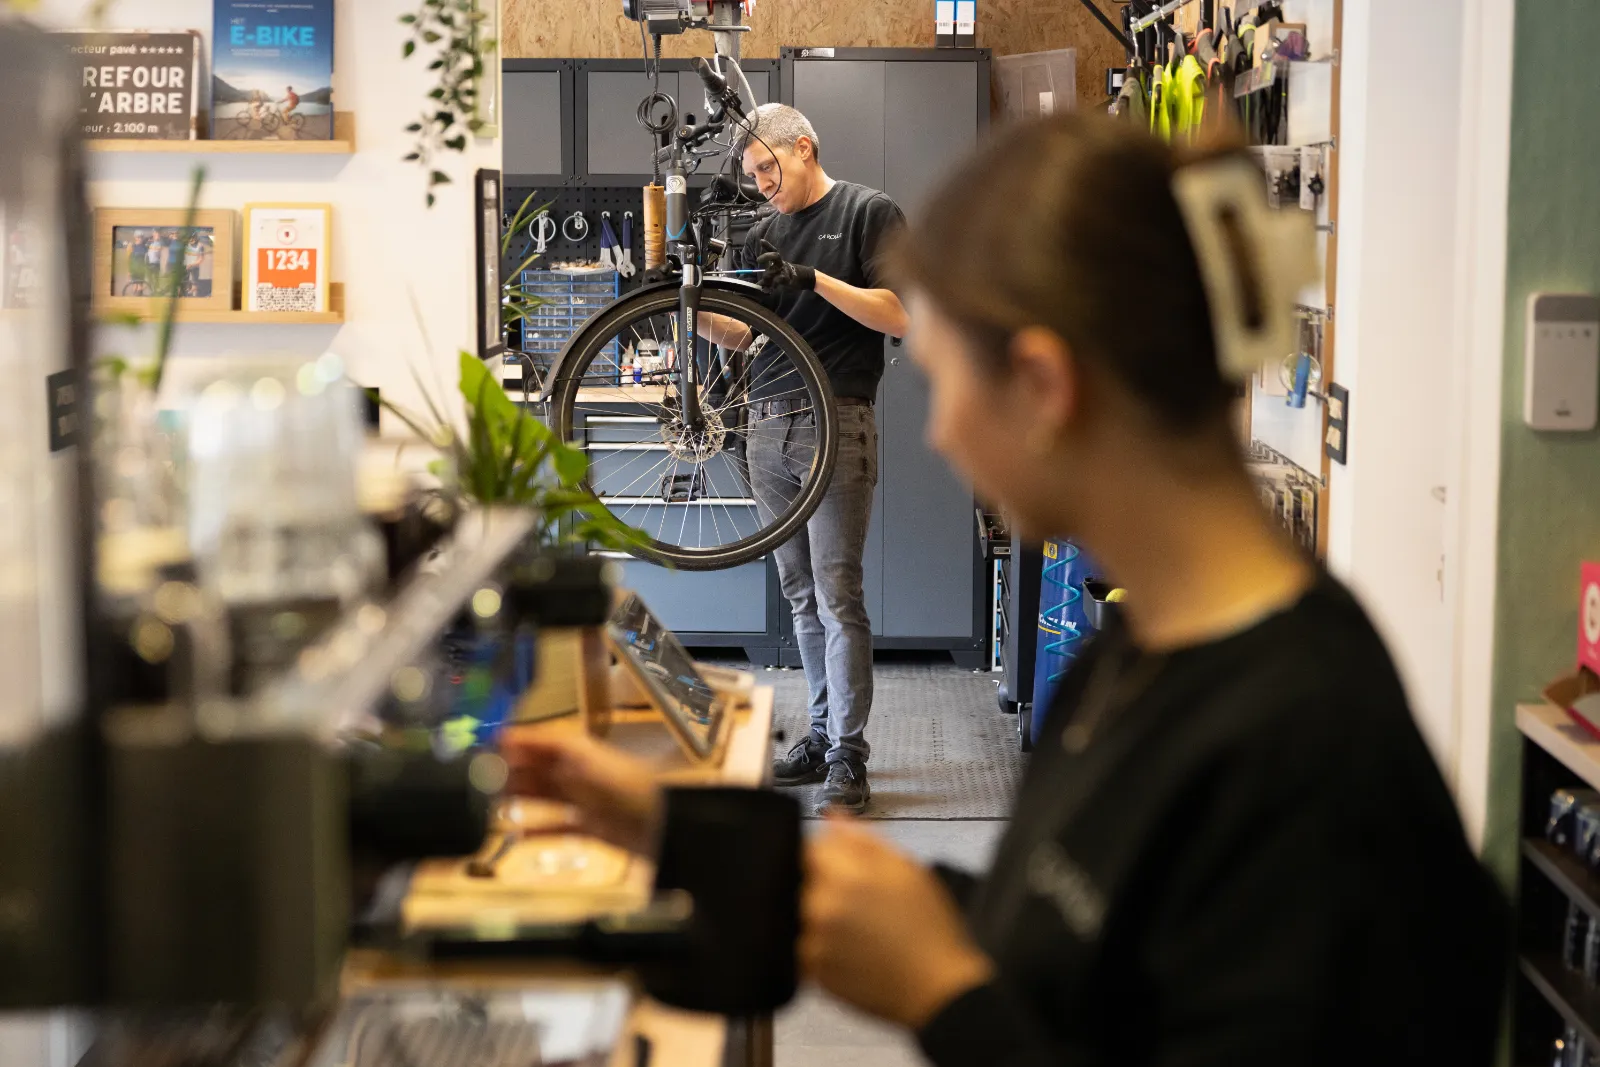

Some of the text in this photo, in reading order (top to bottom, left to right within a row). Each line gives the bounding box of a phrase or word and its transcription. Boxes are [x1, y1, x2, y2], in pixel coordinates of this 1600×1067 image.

[230, 26, 315, 47] E-BIKE
[66, 45, 137, 55] ecteur pavé
[82, 66, 185, 88] REFOUR
[81, 92, 183, 114] 'ARBRE
[82, 124, 103, 133] eur
[113, 122, 145, 133] 2.100
[147, 124, 158, 133] m
[266, 250, 310, 270] 1234
